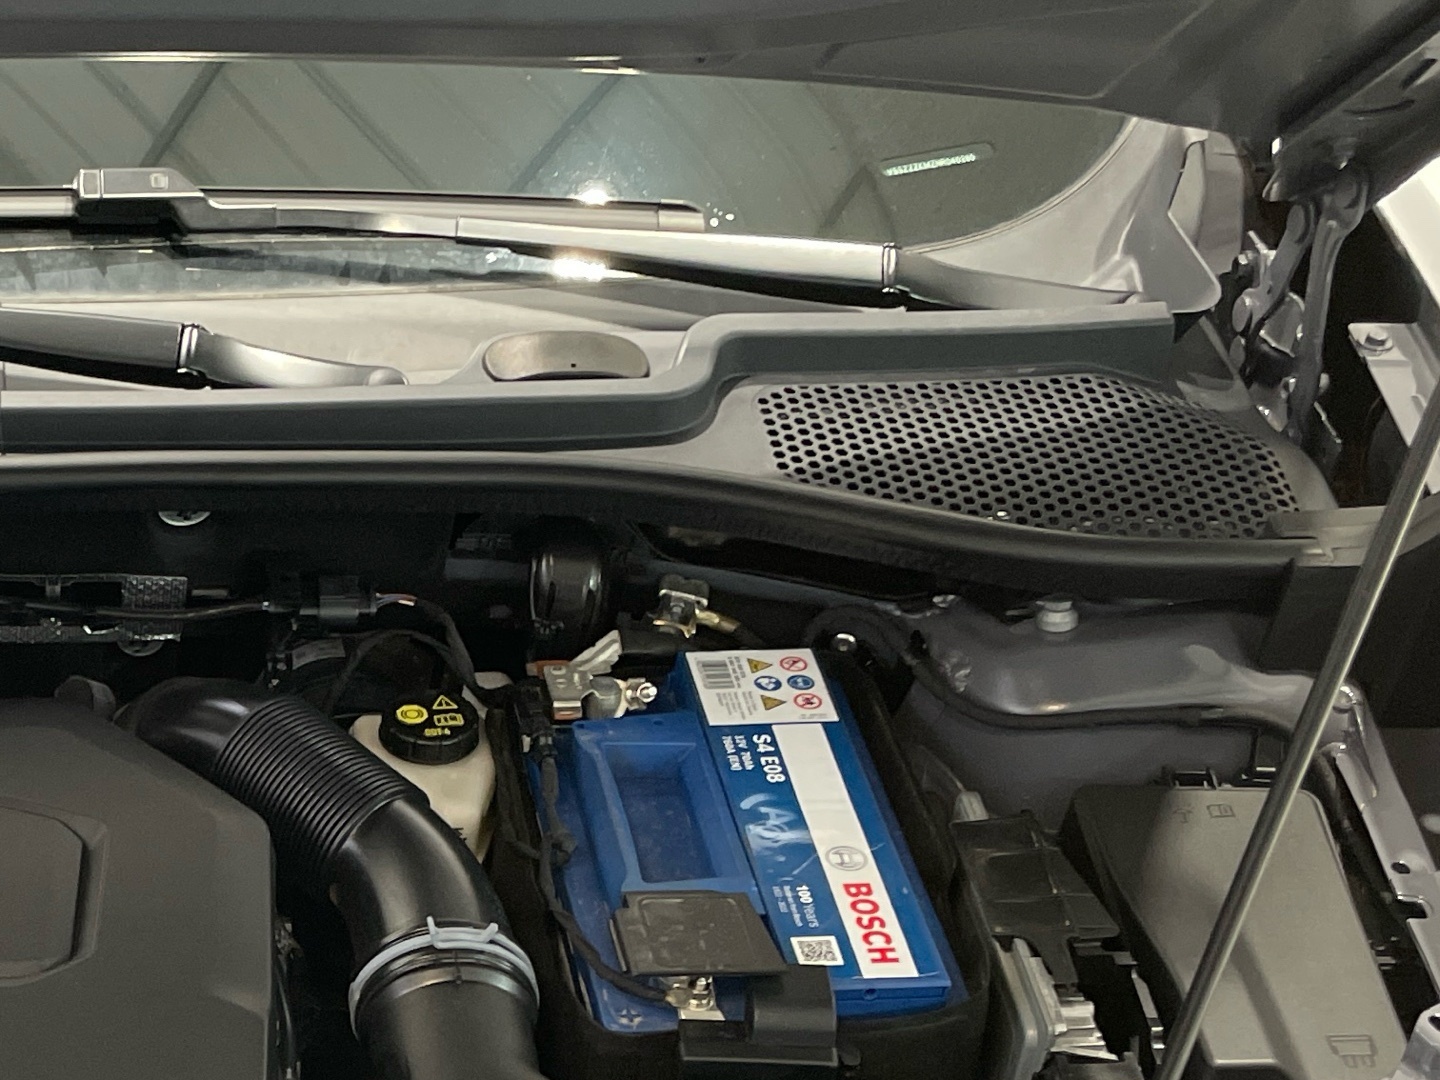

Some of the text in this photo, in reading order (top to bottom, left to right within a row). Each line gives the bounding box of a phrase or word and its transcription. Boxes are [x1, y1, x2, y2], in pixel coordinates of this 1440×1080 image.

[734, 735, 755, 770] 12V 70Ah
[752, 734, 786, 783] S4 E08
[796, 885, 819, 928] 100 Years
[843, 883, 899, 963] BOSCH
